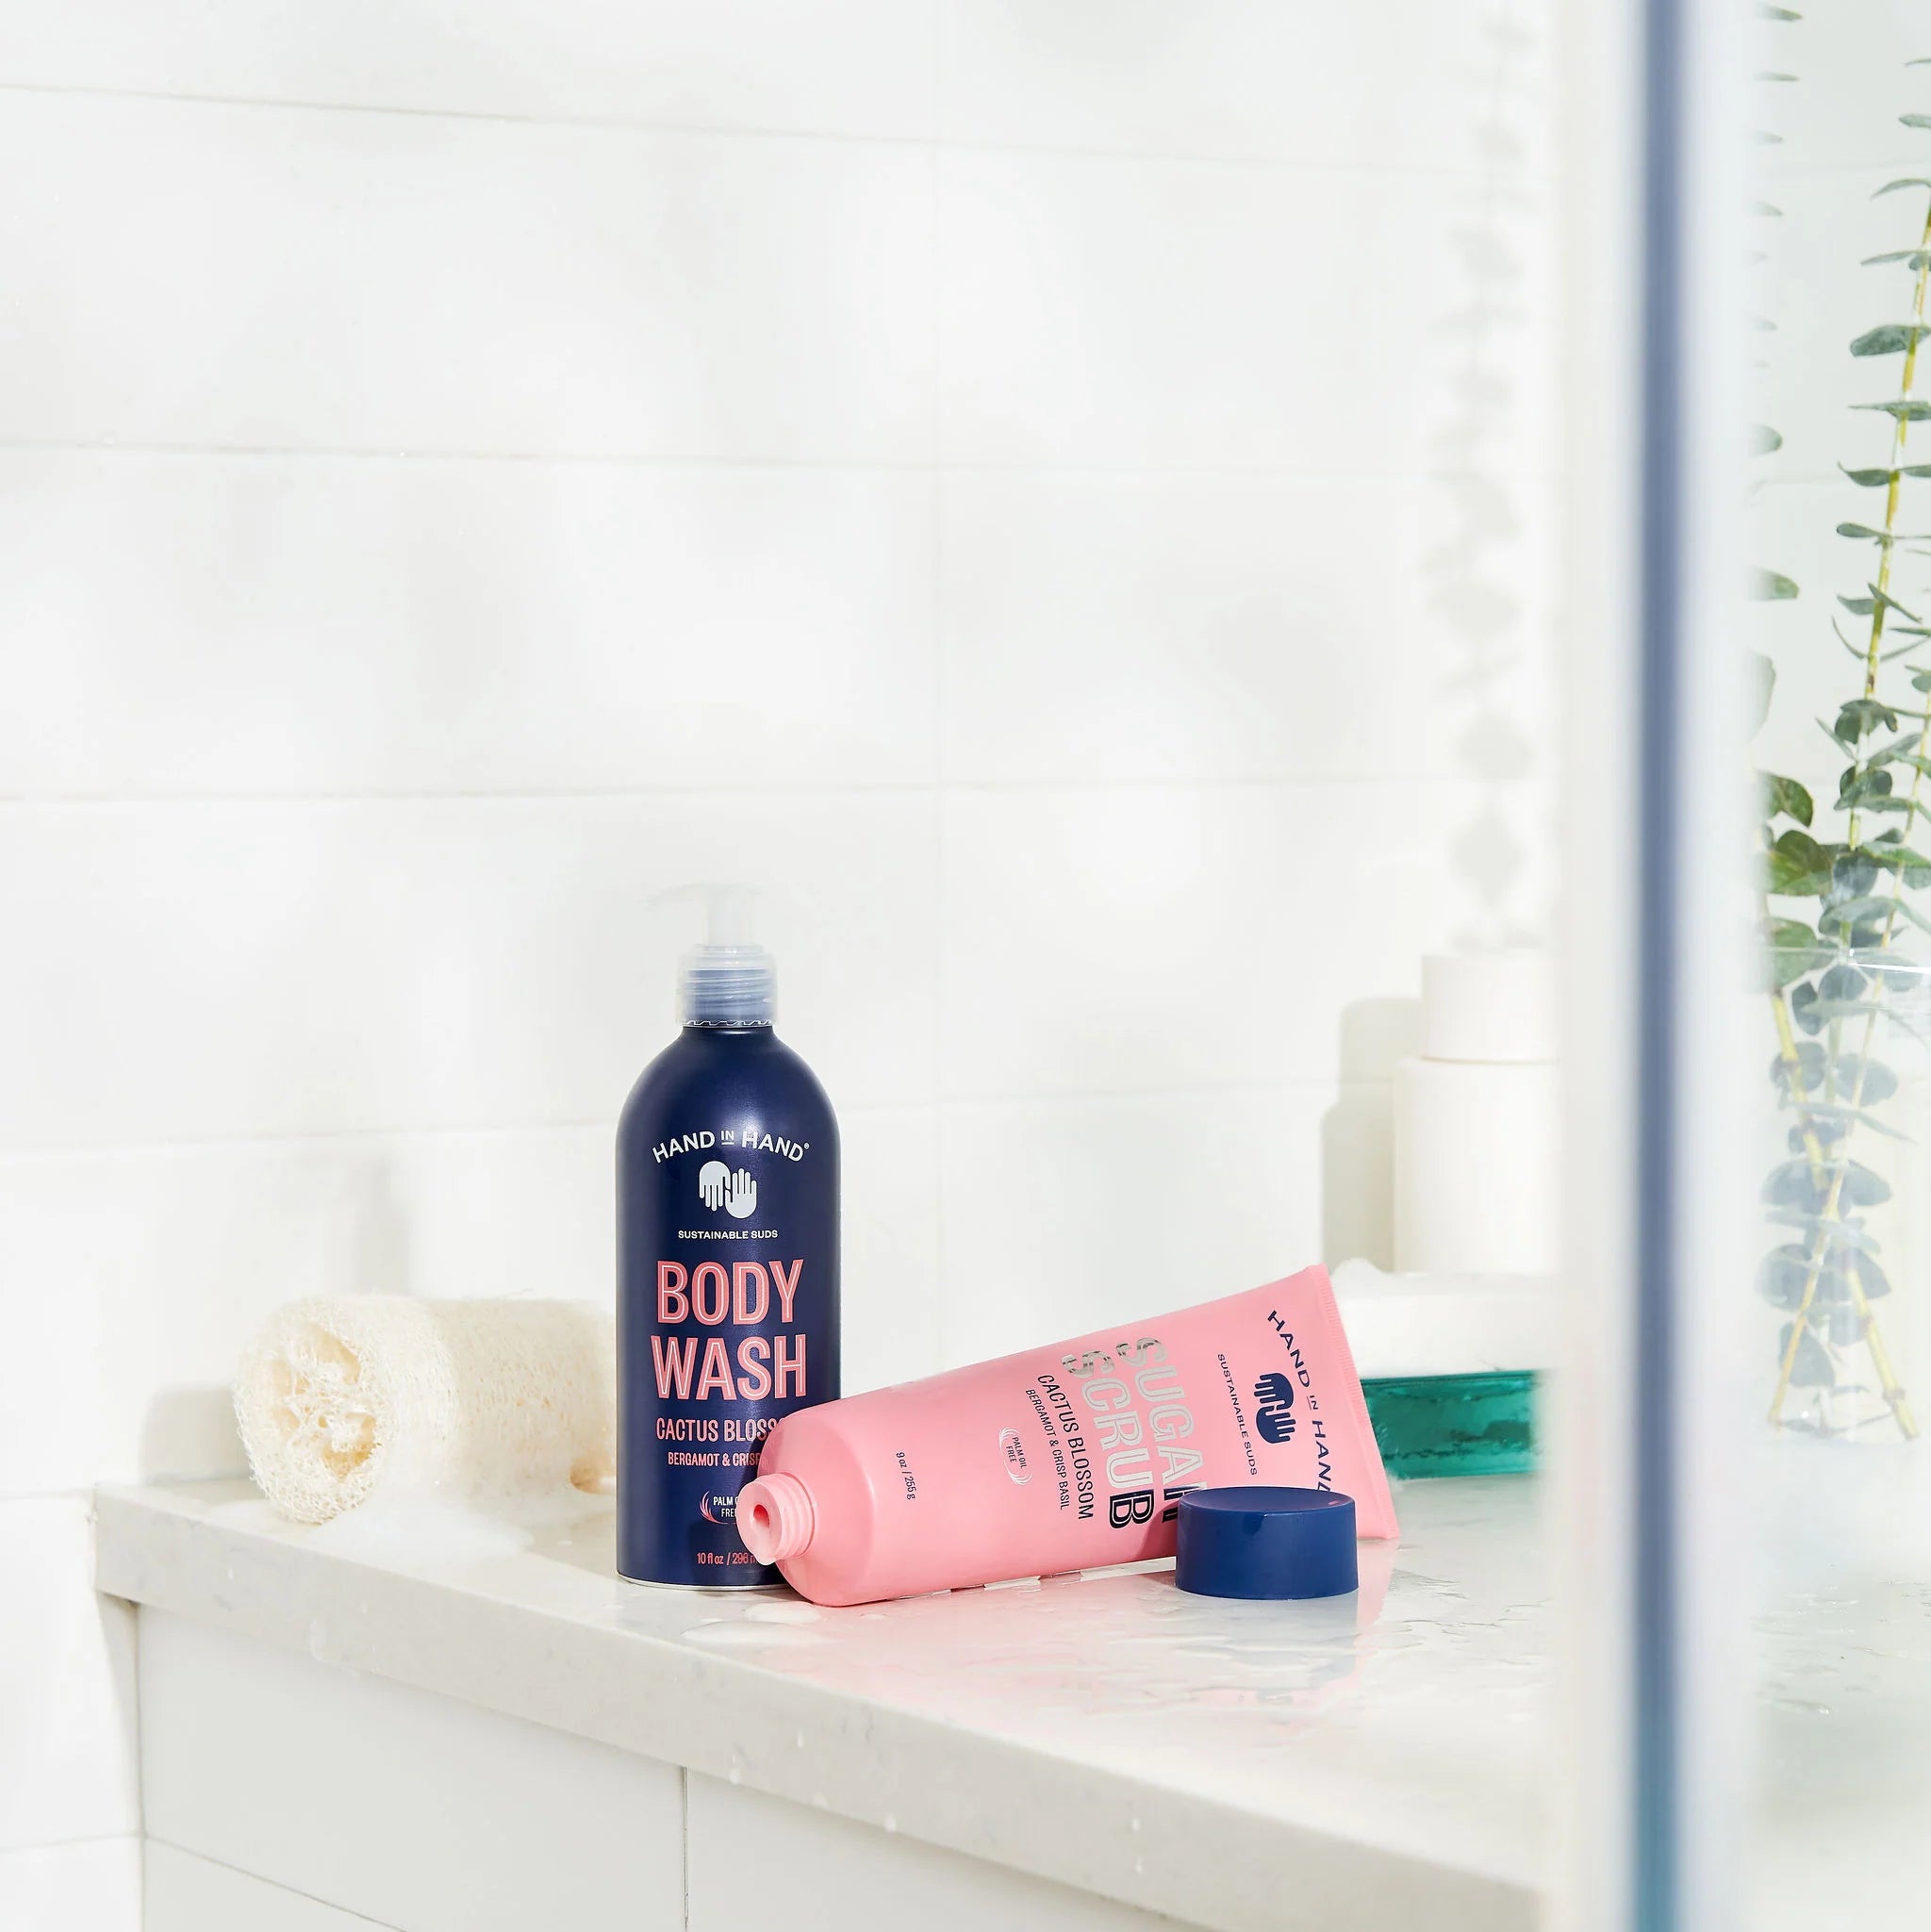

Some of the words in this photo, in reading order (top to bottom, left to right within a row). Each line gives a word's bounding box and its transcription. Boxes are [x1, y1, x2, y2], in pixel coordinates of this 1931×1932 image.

[652, 1131, 716, 1164] HAND
[720, 1130, 734, 1144] IN
[678, 1230, 749, 1240] SUSTAINABLE
[751, 1229, 779, 1239] SUDS
[657, 1259, 804, 1326] BODY
[650, 1333, 807, 1401] WASH
[1267, 1310, 1311, 1388] HAND
[1308, 1395, 1319, 1411] IN
[1025, 1389, 1057, 1437] BERGAMOT
[1217, 1353, 1249, 1438] SUSTAINABLE
[1245, 1441, 1258, 1476] SUDS
[655, 1417, 719, 1443] CACTUS
[723, 1417, 784, 1442] BLOSS
[1048, 1439, 1060, 1447] &
[1061, 1350, 1155, 1529] SCRUB
[668, 1452, 719, 1466] BERGAMOT
[722, 1453, 731, 1466] &
[1006, 1445, 1017, 1462] FREE
[1012, 1436, 1025, 1456] PALM
[1037, 1374, 1080, 1433] CACTUS
[1067, 1437, 1095, 1520] BLOSSOM
[899, 1459, 907, 1468] oz
[904, 1476, 916, 1492] 255
[1018, 1457, 1027, 1469] OIL
[1052, 1449, 1067, 1478] CRISP
[713, 1495, 734, 1506] PALM
[1058, 1482, 1070, 1511] BASIL
[697, 1552, 706, 1564] 10
[714, 1555, 724, 1564] oz
